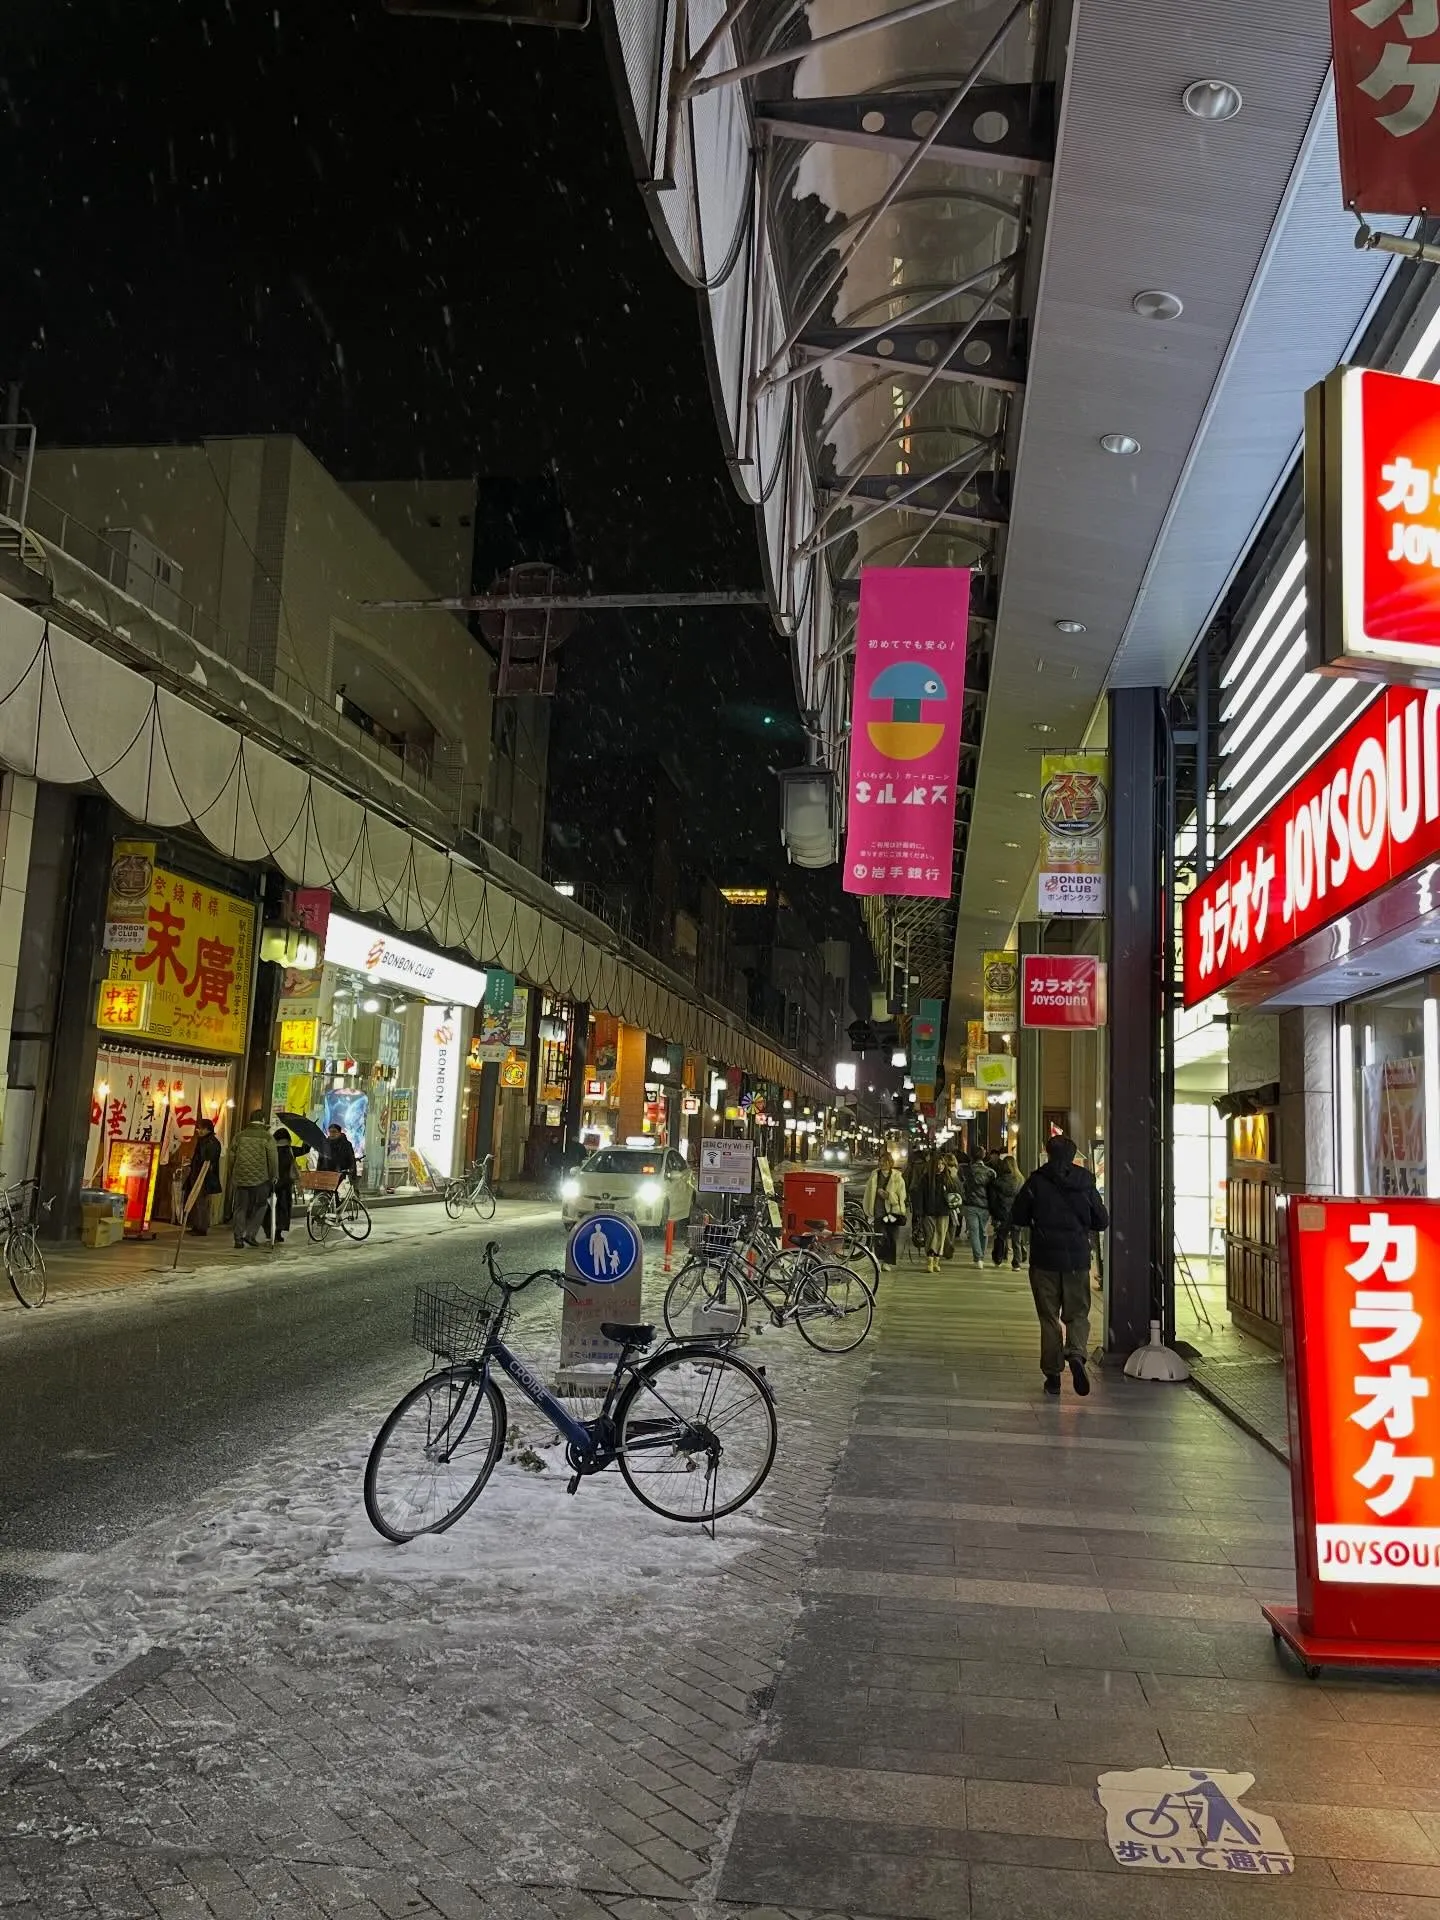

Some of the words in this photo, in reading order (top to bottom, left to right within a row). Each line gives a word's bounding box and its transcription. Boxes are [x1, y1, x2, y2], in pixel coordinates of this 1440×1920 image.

[872, 866, 941, 881] 岩手銀行
[1051, 875, 1102, 885] BONBON
[1060, 885, 1092, 893] CLUB
[1199, 846, 1275, 980] カラオケ
[381, 951, 415, 974] BONBON
[415, 961, 435, 979] CLUB
[1030, 977, 1092, 993] カラオケ
[103, 1005, 138, 1022] そば
[1031, 995, 1088, 1006] JOYSOUND
[435, 1048, 447, 1106] BONBON
[432, 1108, 446, 1142] CLUB
[1344, 1212, 1435, 1517] カラオケ
[509, 1360, 546, 1402] CROIRE
[1115, 1840, 1293, 1875] 歩いて通行
